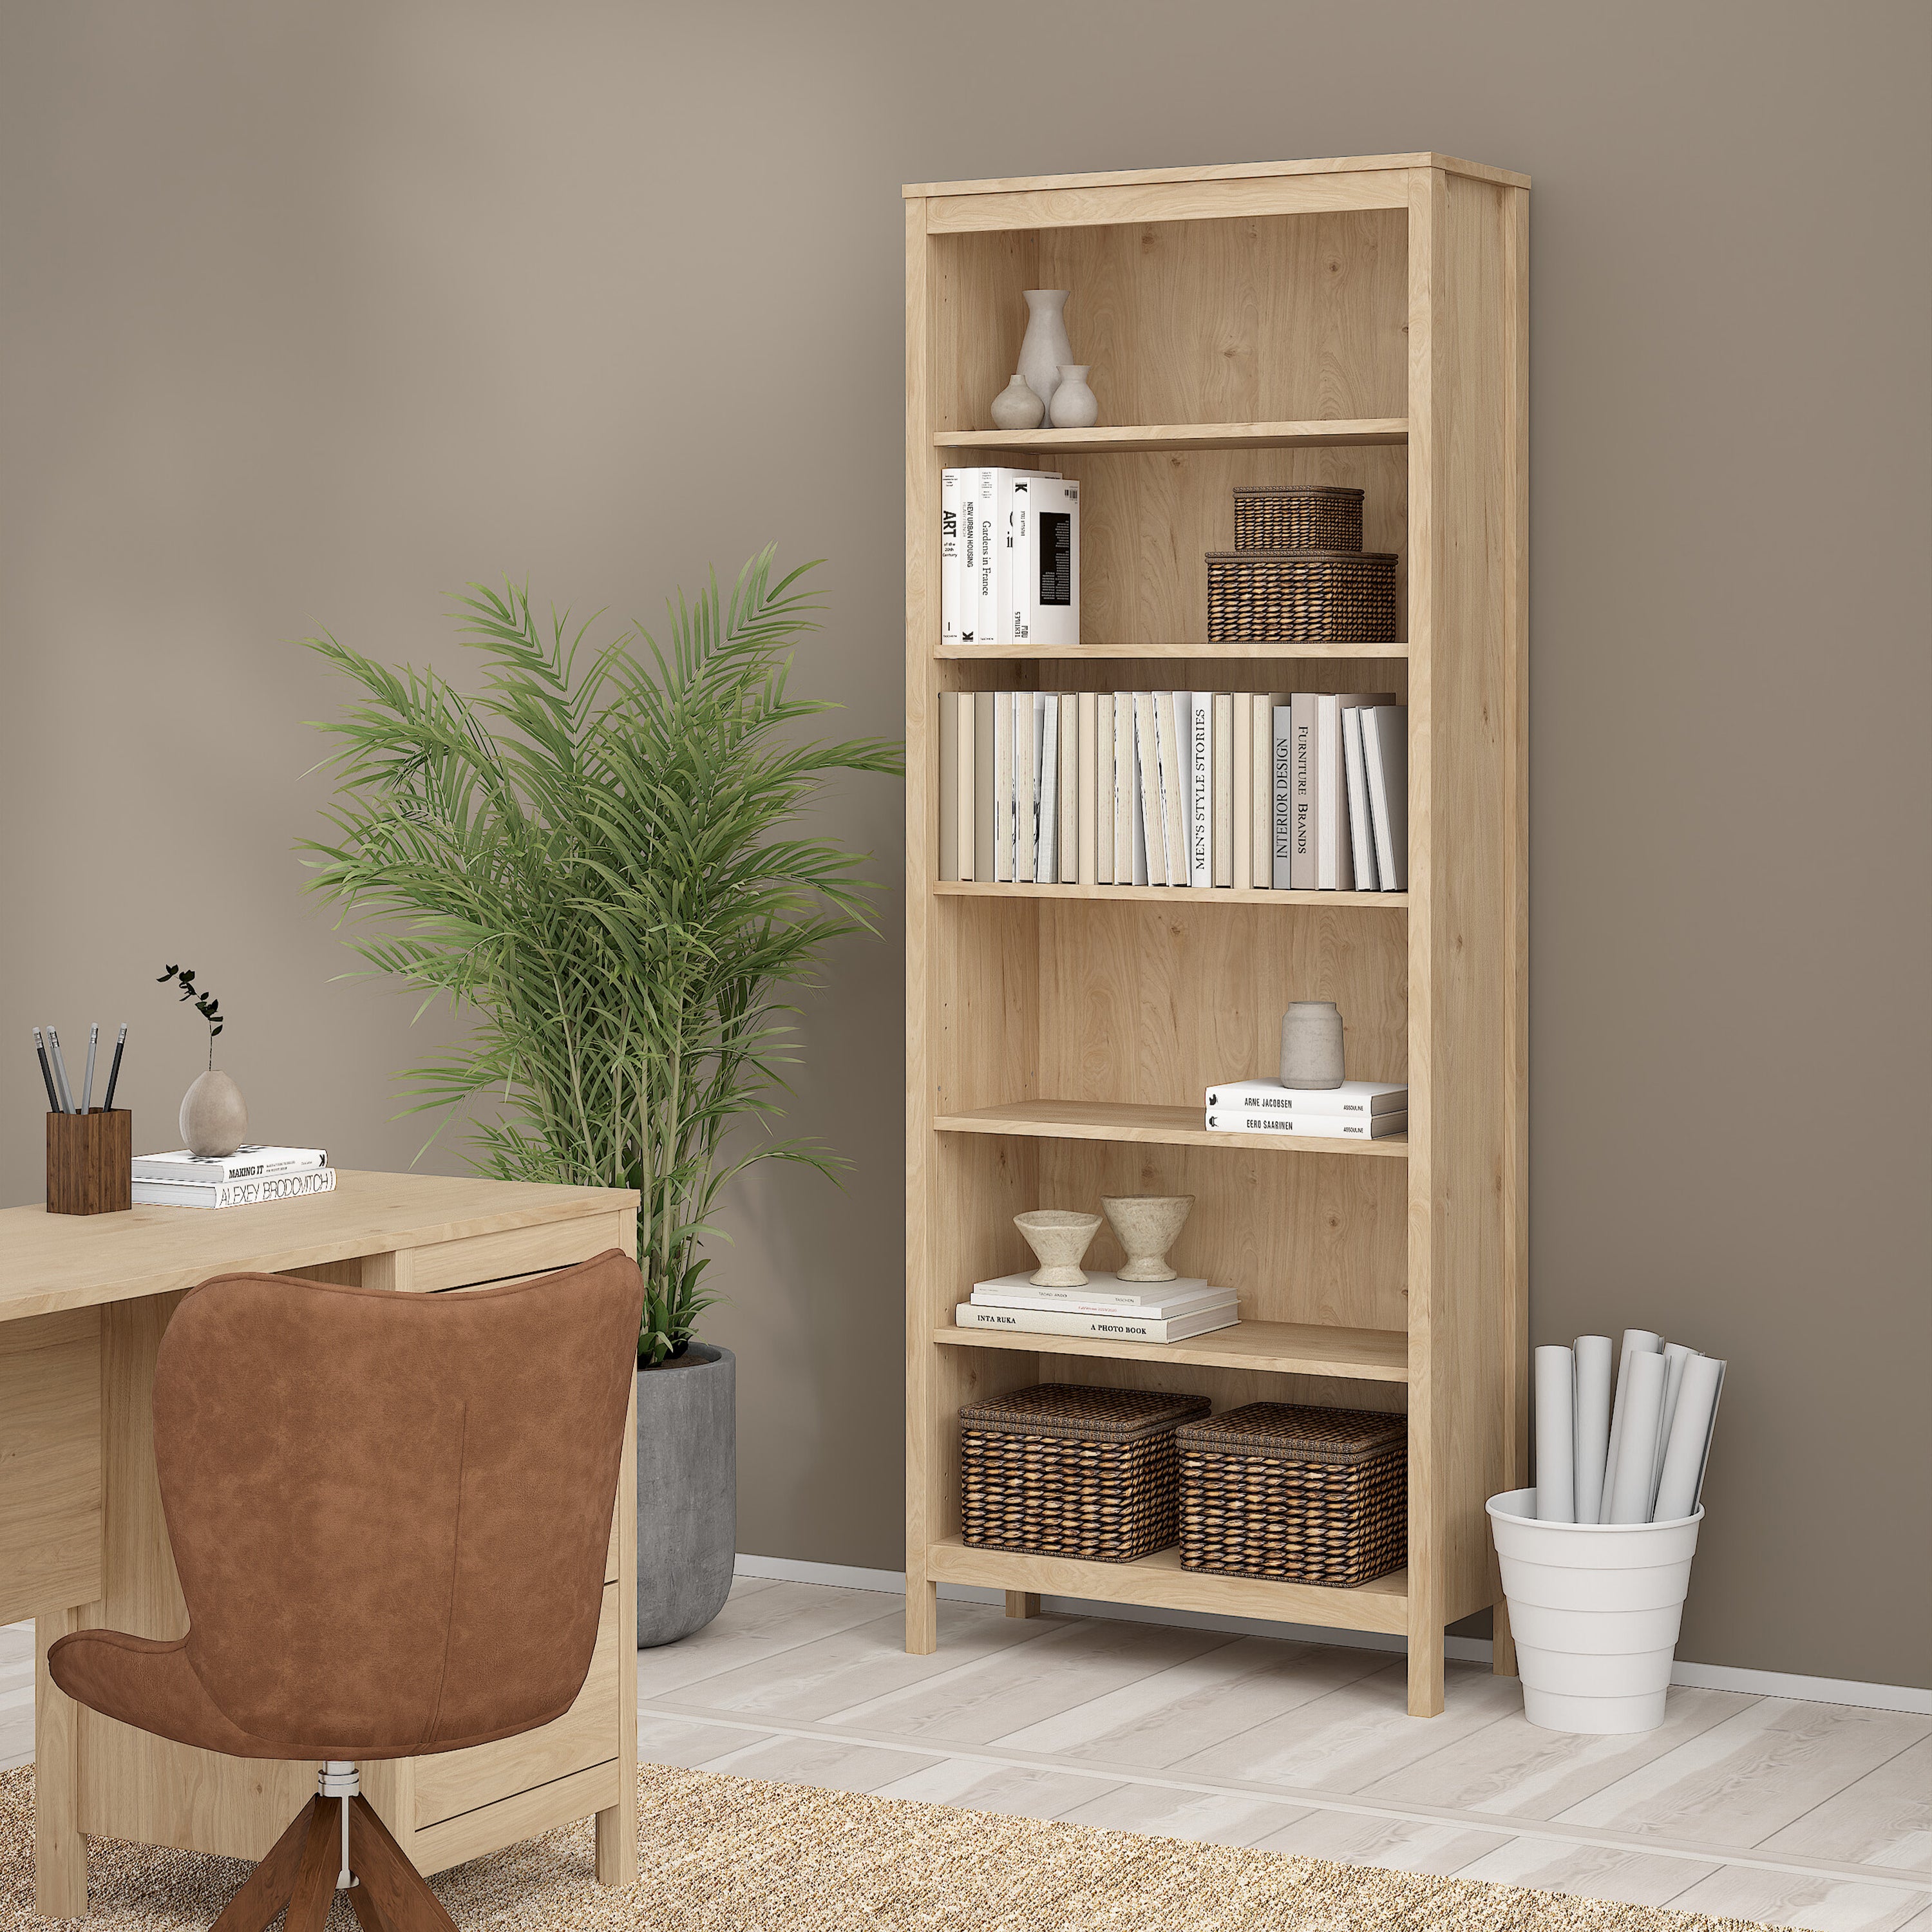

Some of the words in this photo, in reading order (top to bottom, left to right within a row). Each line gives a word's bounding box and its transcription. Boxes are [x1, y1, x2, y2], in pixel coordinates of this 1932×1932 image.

[943, 510, 956, 538] ART
[982, 520, 991, 555] Gardens
[982, 557, 991, 565] in
[982, 567, 991, 596] France
[1195, 708, 1205, 771] STORIES
[1276, 737, 1288, 792] DESIGN
[1195, 774, 1205, 822] STYLE
[1276, 794, 1288, 858] INTERIOR
[1195, 826, 1205, 870] MEN'S
[1244, 1097, 1260, 1106] ARNE
[1262, 1099, 1292, 1108] JACOBSEN
[1247, 1119, 1261, 1128] EERO
[1263, 1120, 1293, 1130] SAARINEN
[229, 1166, 256, 1179] MAKING
[256, 1165, 264, 1175] IT
[219, 1184, 260, 1206] ALEXEY
[263, 1173, 328, 1200] BRODOVITCH
